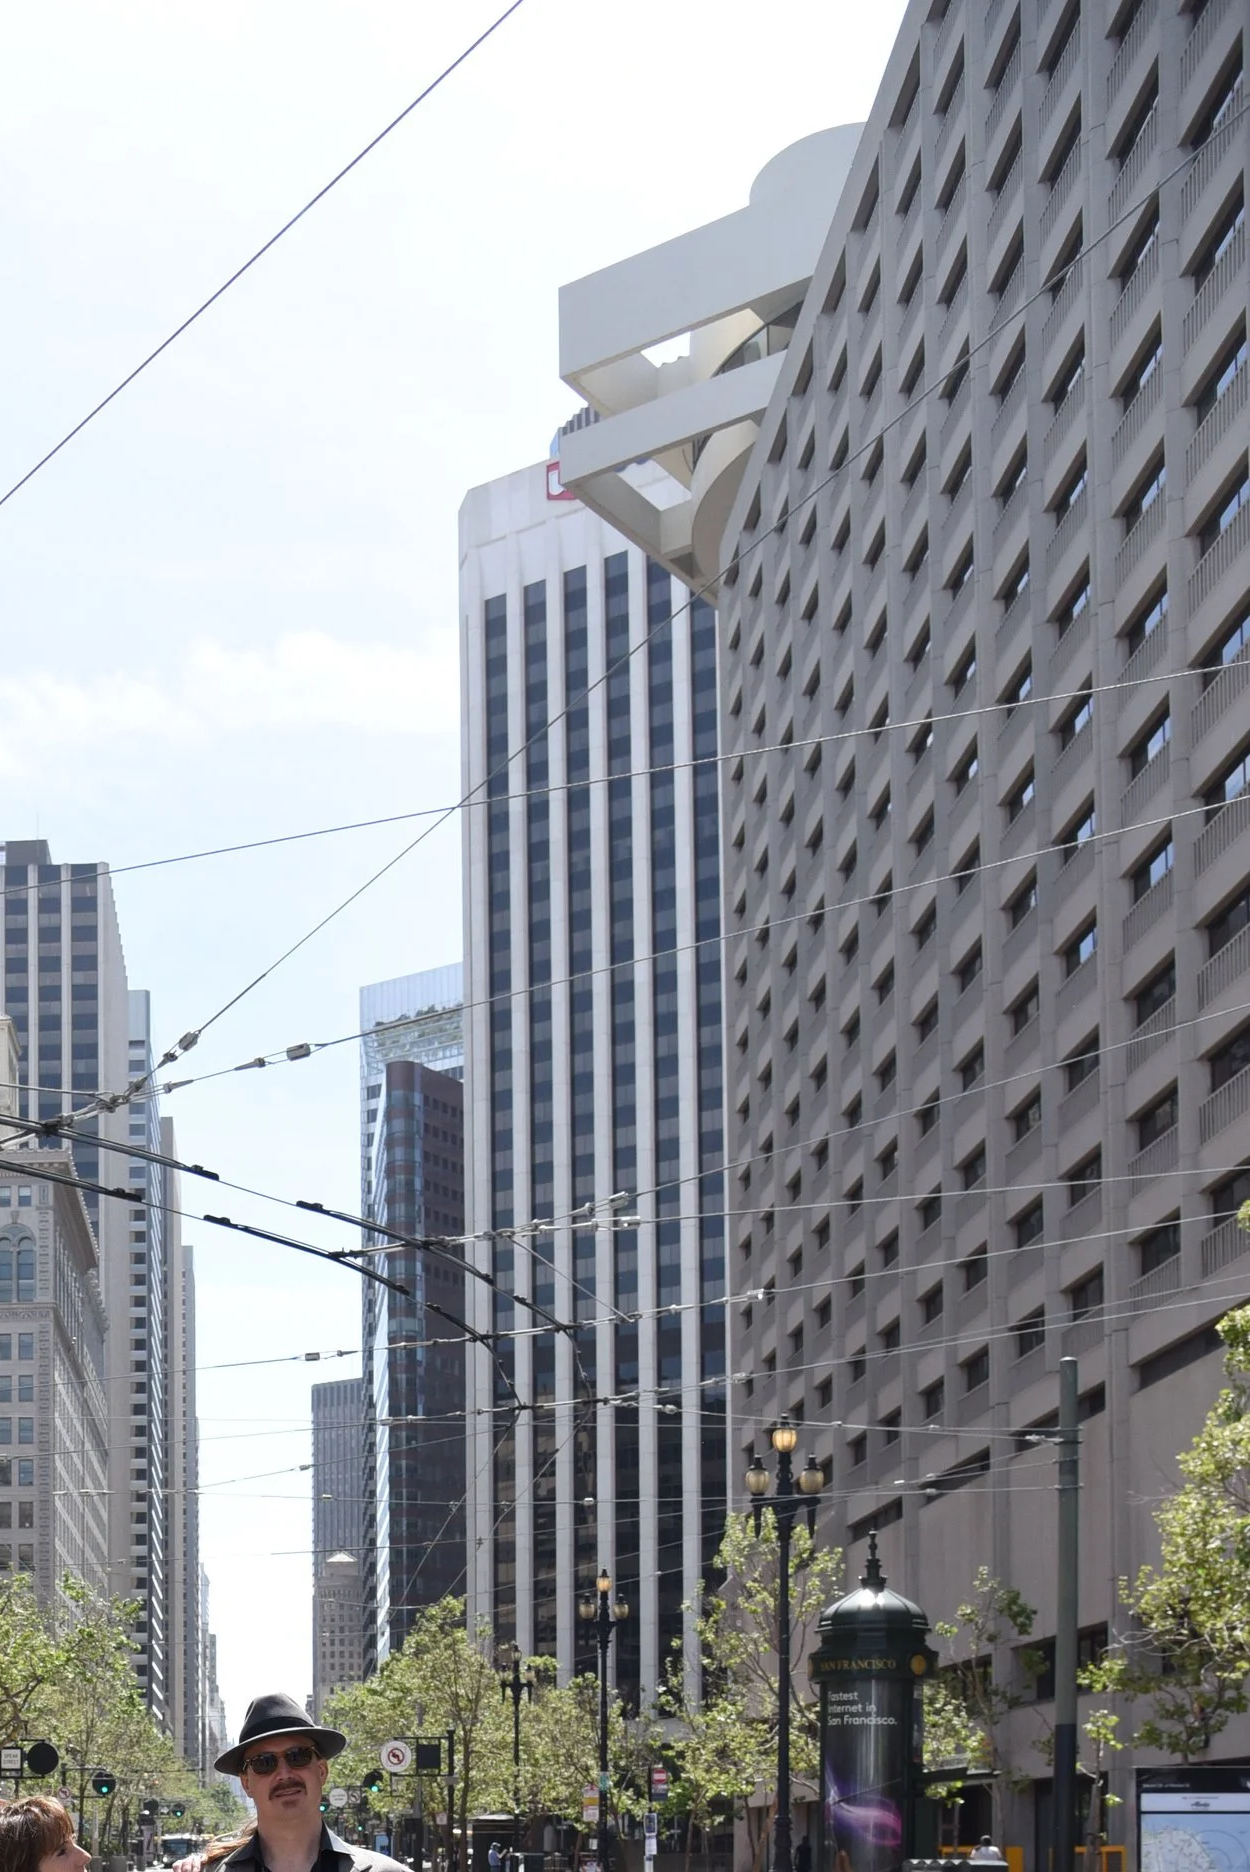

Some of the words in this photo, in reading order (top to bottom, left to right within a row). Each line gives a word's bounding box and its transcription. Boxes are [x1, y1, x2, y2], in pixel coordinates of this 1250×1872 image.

[820, 1661, 835, 1671] SAN
[836, 1659, 897, 1671] FRANCISCO
[828, 1691, 859, 1701] Fastest
[866, 1702, 877, 1714] in
[827, 1715, 842, 1726] San
